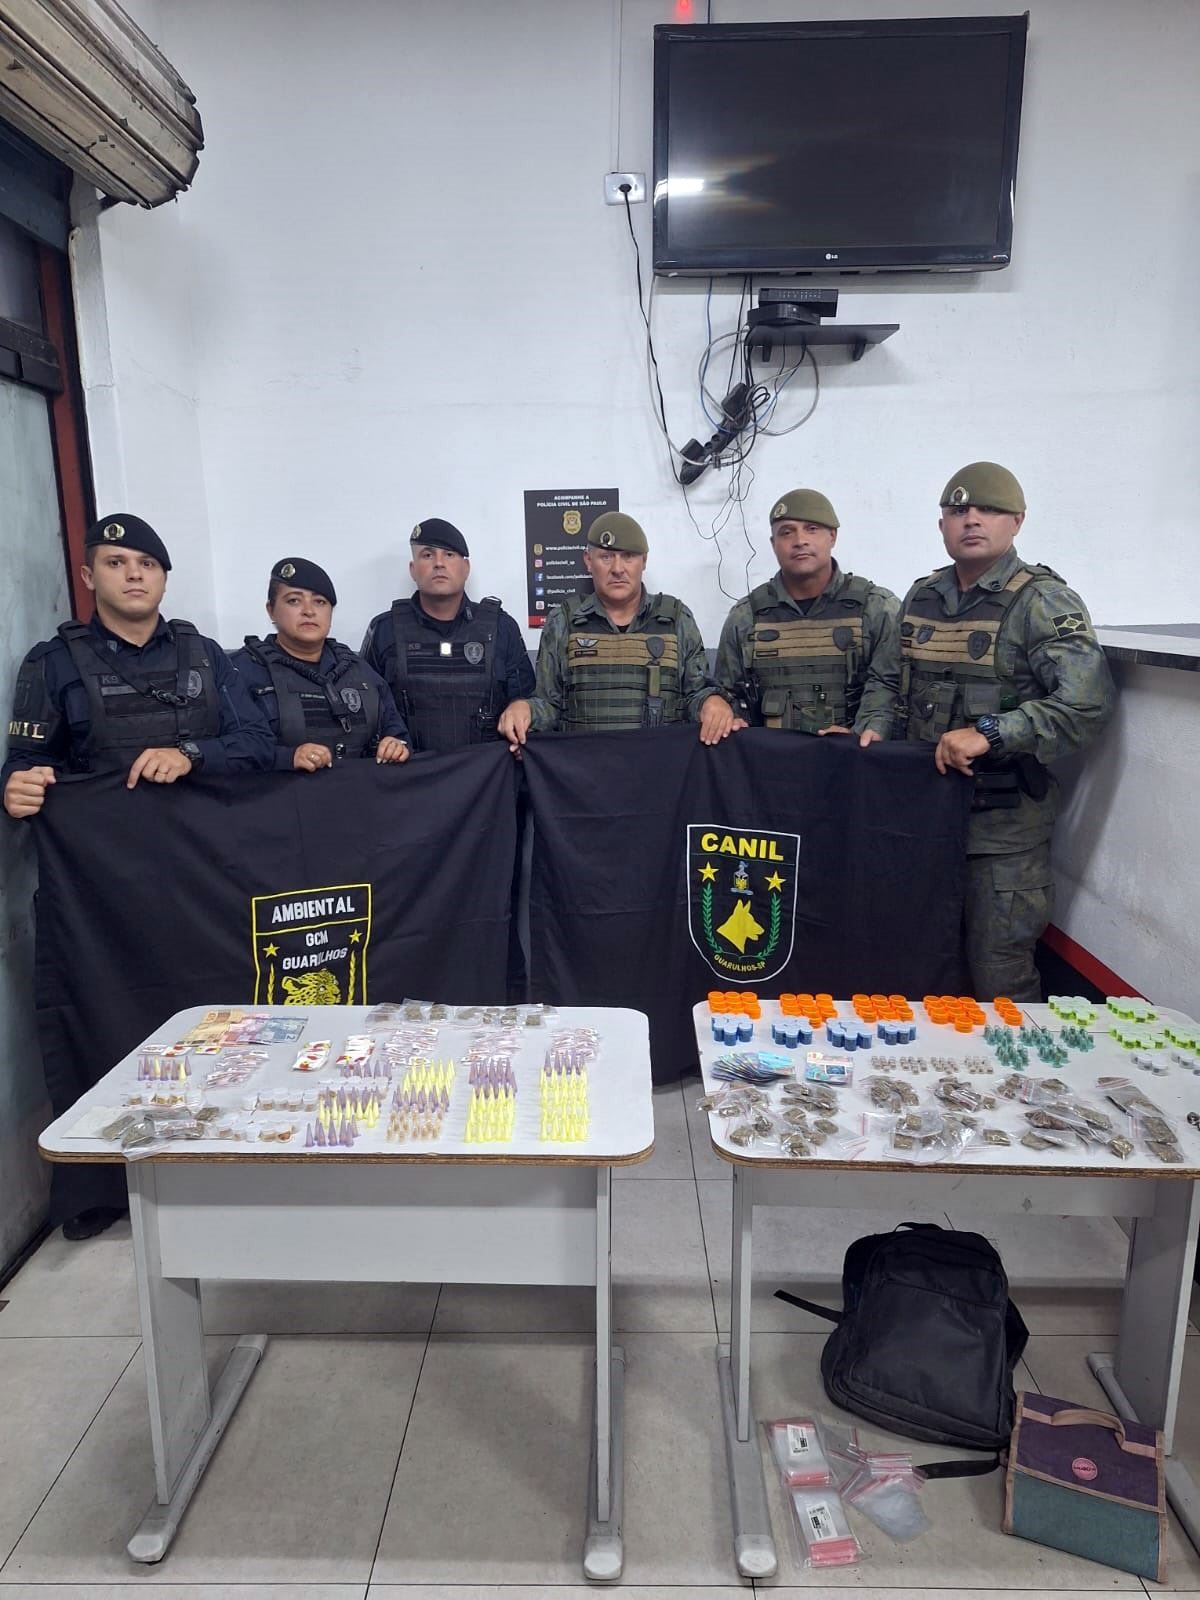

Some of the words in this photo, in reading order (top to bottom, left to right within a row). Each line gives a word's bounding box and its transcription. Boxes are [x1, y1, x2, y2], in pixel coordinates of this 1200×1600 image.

[701, 832, 784, 861] CANIL
[271, 896, 355, 924] AMBIENTAL
[305, 930, 329, 947] GCM
[713, 954, 766, 972] GUARULHOS-SP
